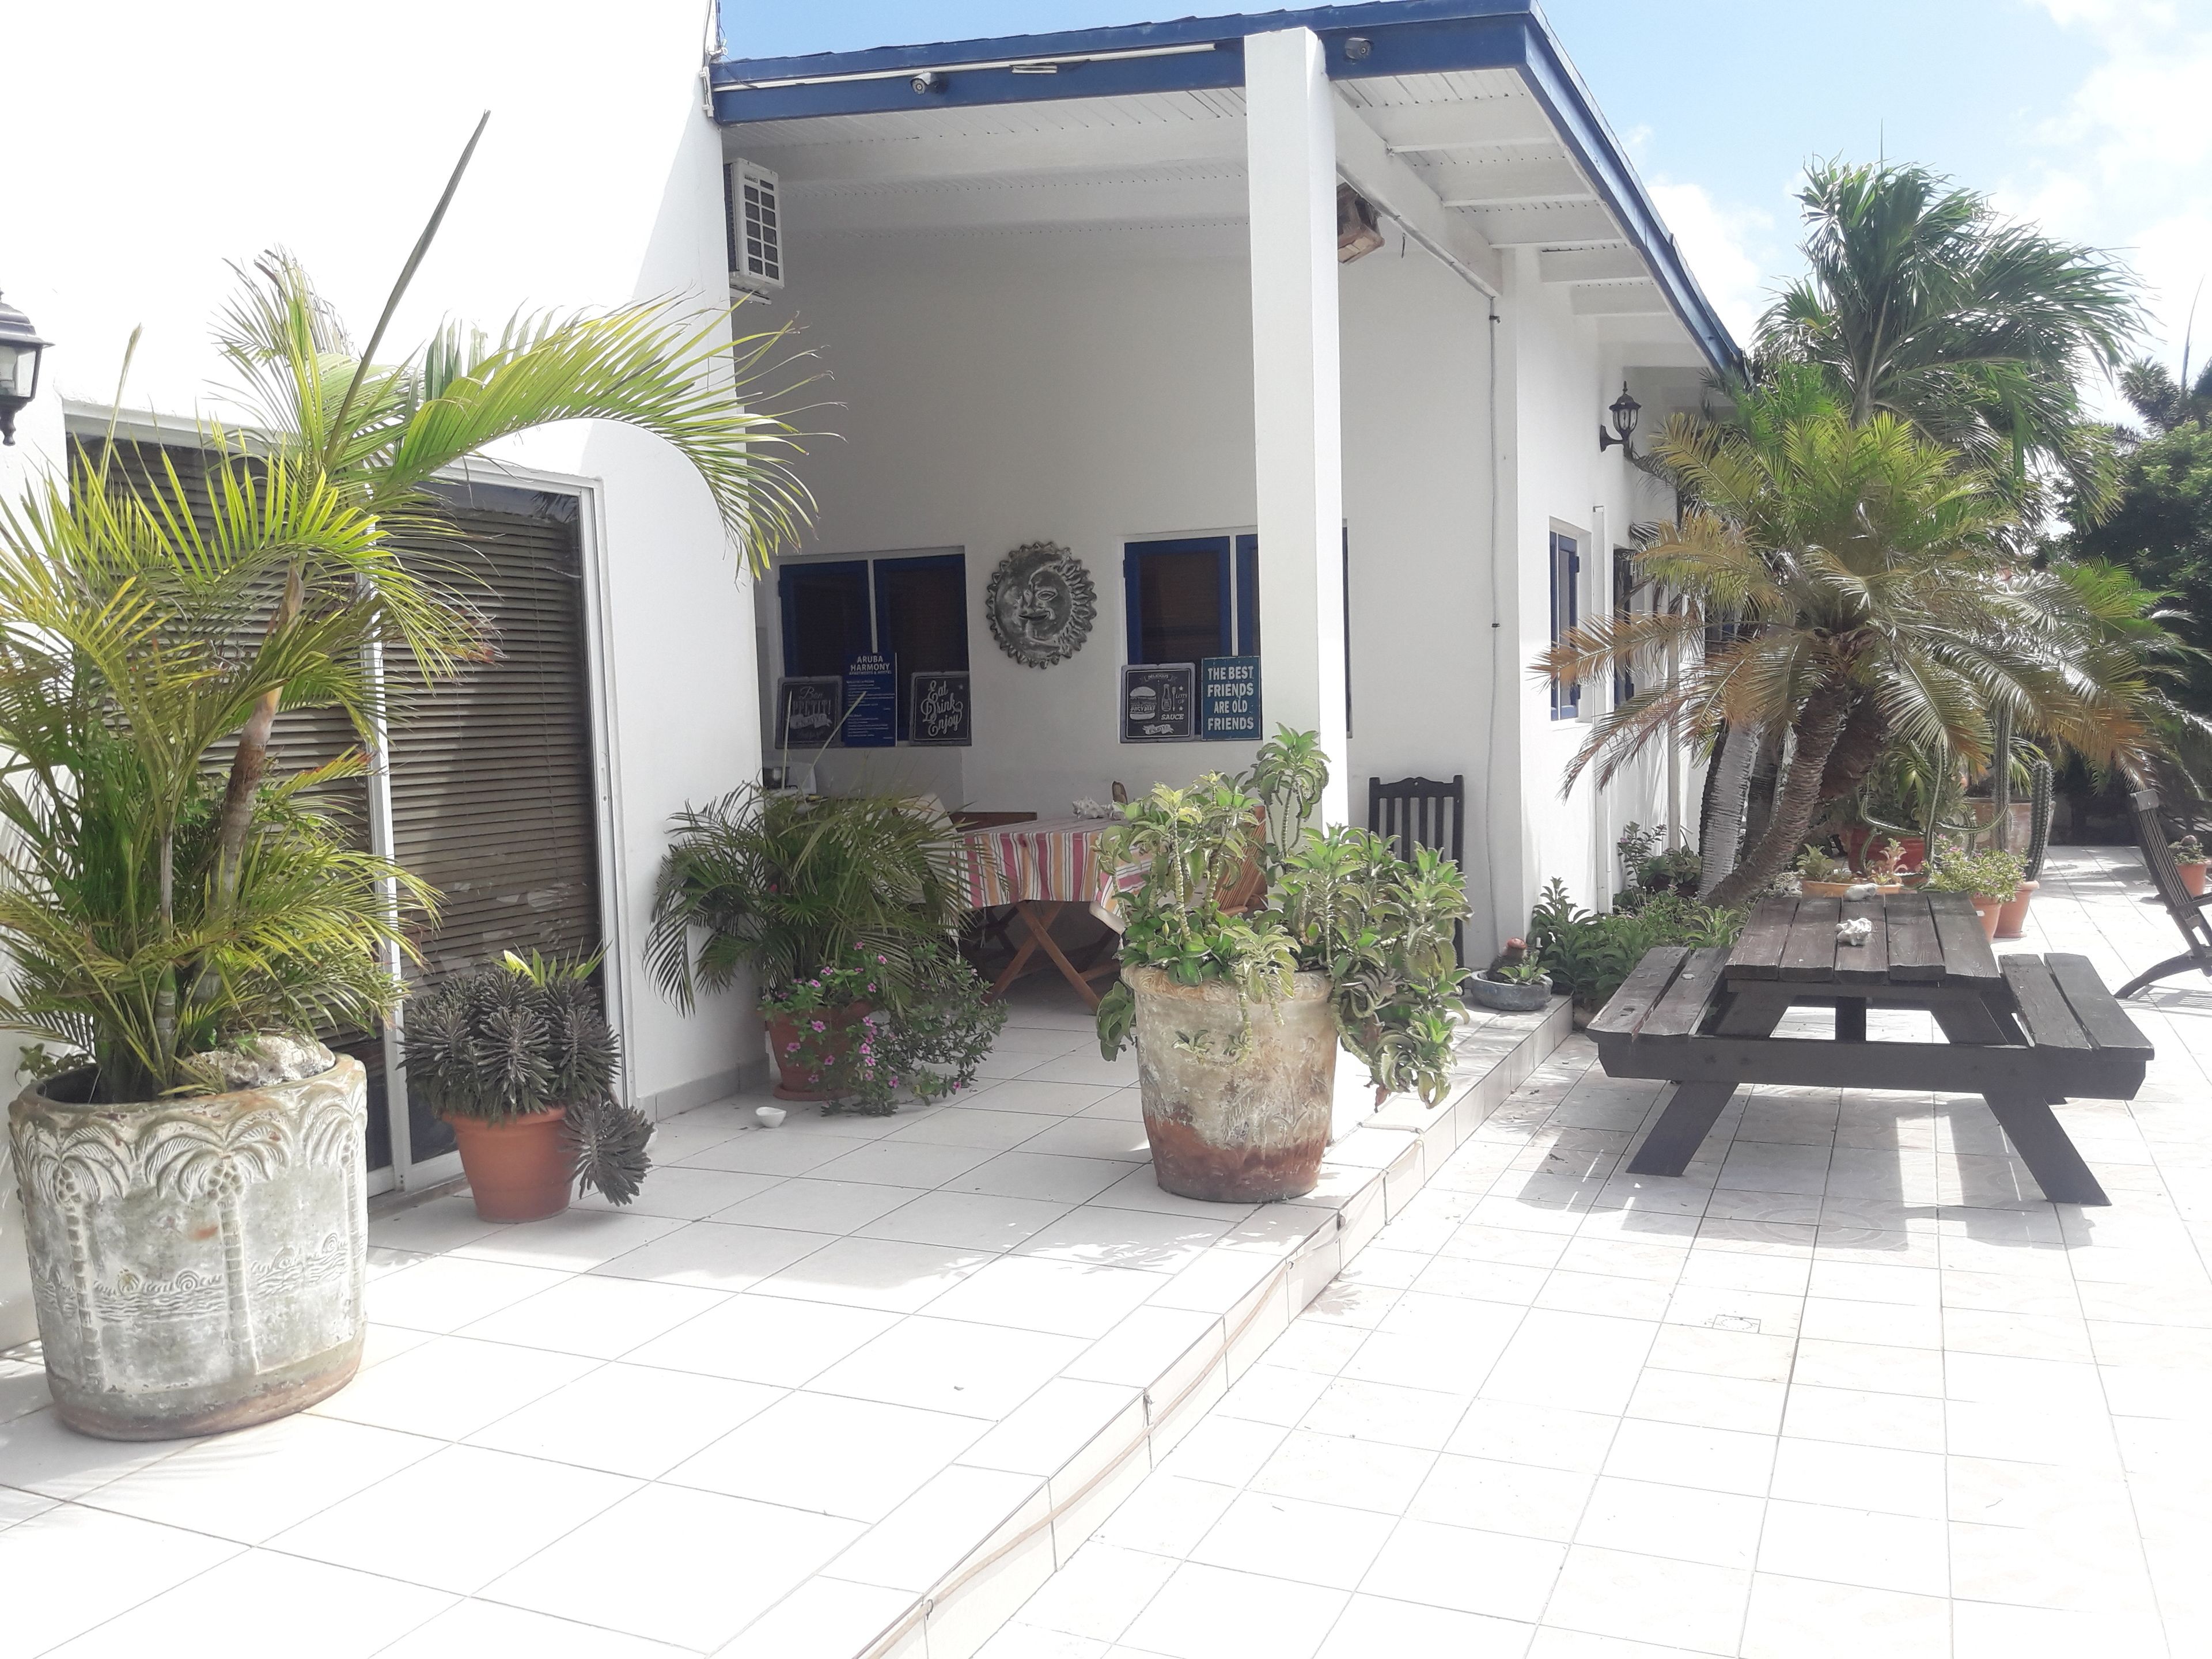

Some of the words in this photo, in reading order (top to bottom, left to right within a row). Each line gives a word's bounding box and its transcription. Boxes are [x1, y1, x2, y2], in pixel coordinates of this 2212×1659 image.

[857, 655, 883, 664] ARUBA
[850, 662, 890, 672] HARMONY
[1207, 667, 1226, 680] THE
[1228, 666, 1254, 680] BEST
[798, 686, 823, 700] Bon
[928, 680, 949, 703] Eat
[1207, 683, 1254, 697] FRIENDS
[921, 692, 964, 723] Drink
[1214, 700, 1230, 714] ARE
[1232, 700, 1248, 713] OLD
[928, 713, 962, 737] Enjoy
[1208, 717, 1254, 730] FRIENDS
